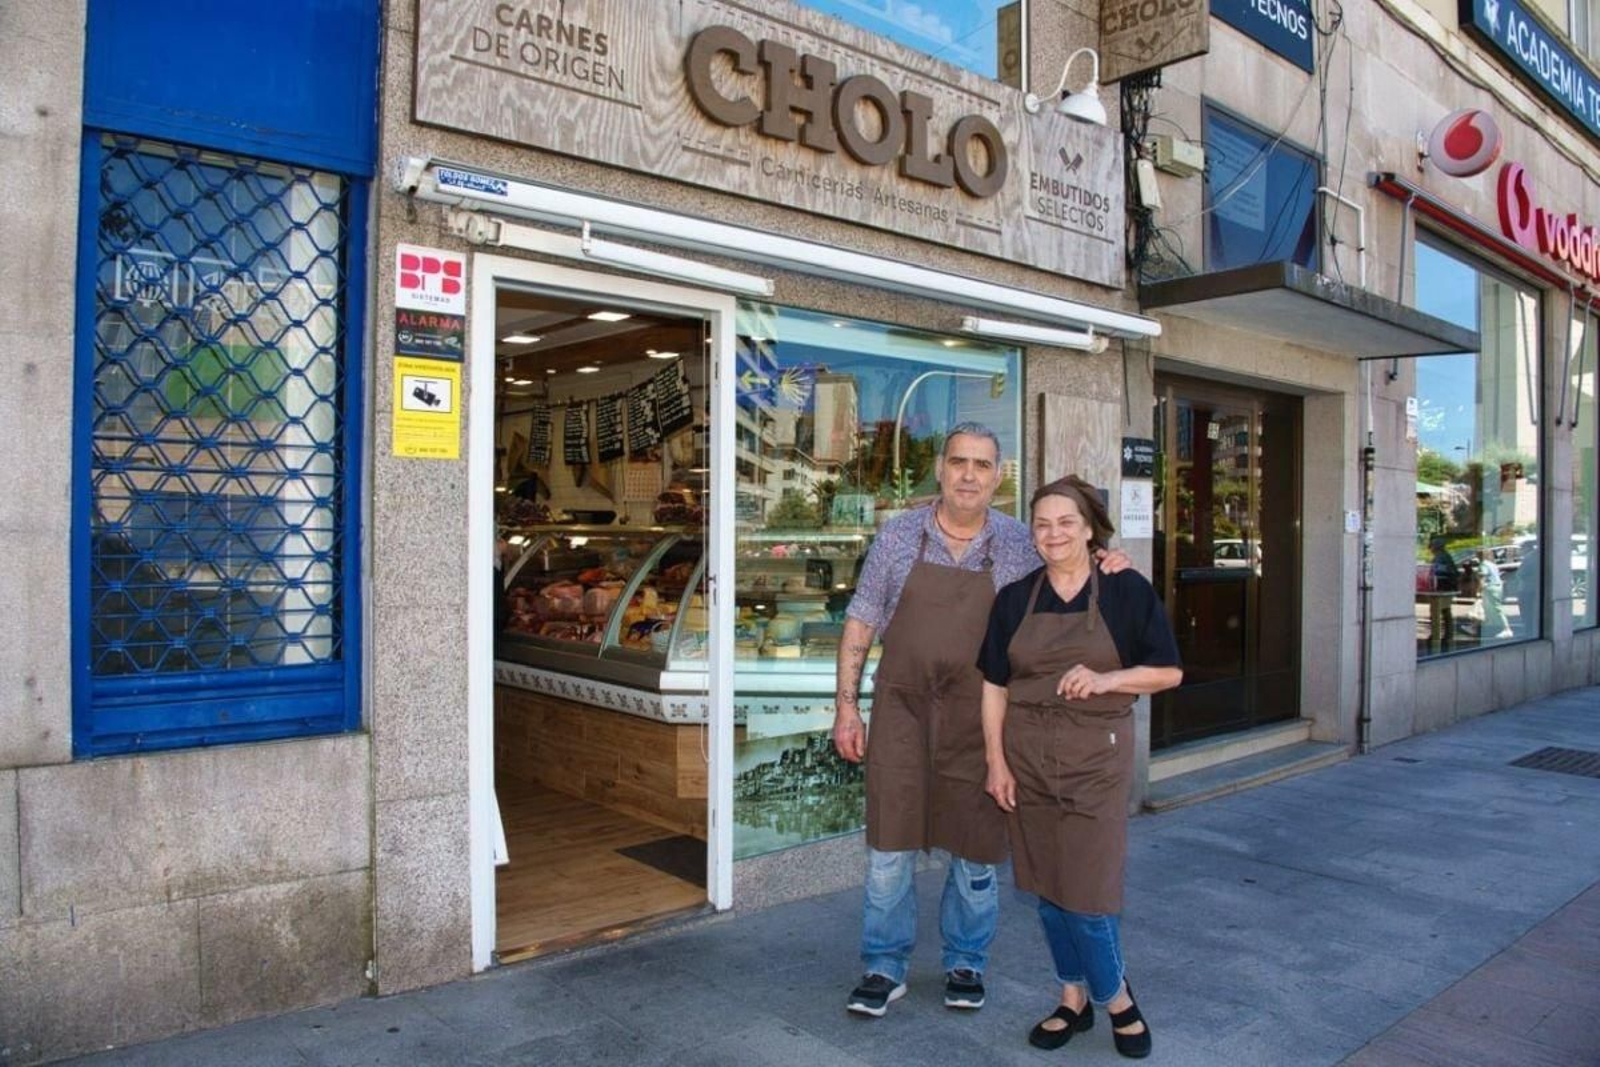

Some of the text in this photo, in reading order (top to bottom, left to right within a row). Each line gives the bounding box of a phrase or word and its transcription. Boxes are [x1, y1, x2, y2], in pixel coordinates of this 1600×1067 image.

[495, 3, 608, 57] CARNES
[473, 26, 625, 92] DE ORIGEN
[1506, 10, 1587, 115] ACADEMIA
[684, 25, 1008, 199] CHOLO
[872, 187, 949, 224] Artesanas
[1030, 172, 1110, 214] EMBUTIDOS
[1037, 198, 1104, 232] SELECTOS
[399, 312, 461, 331] ALARMA
